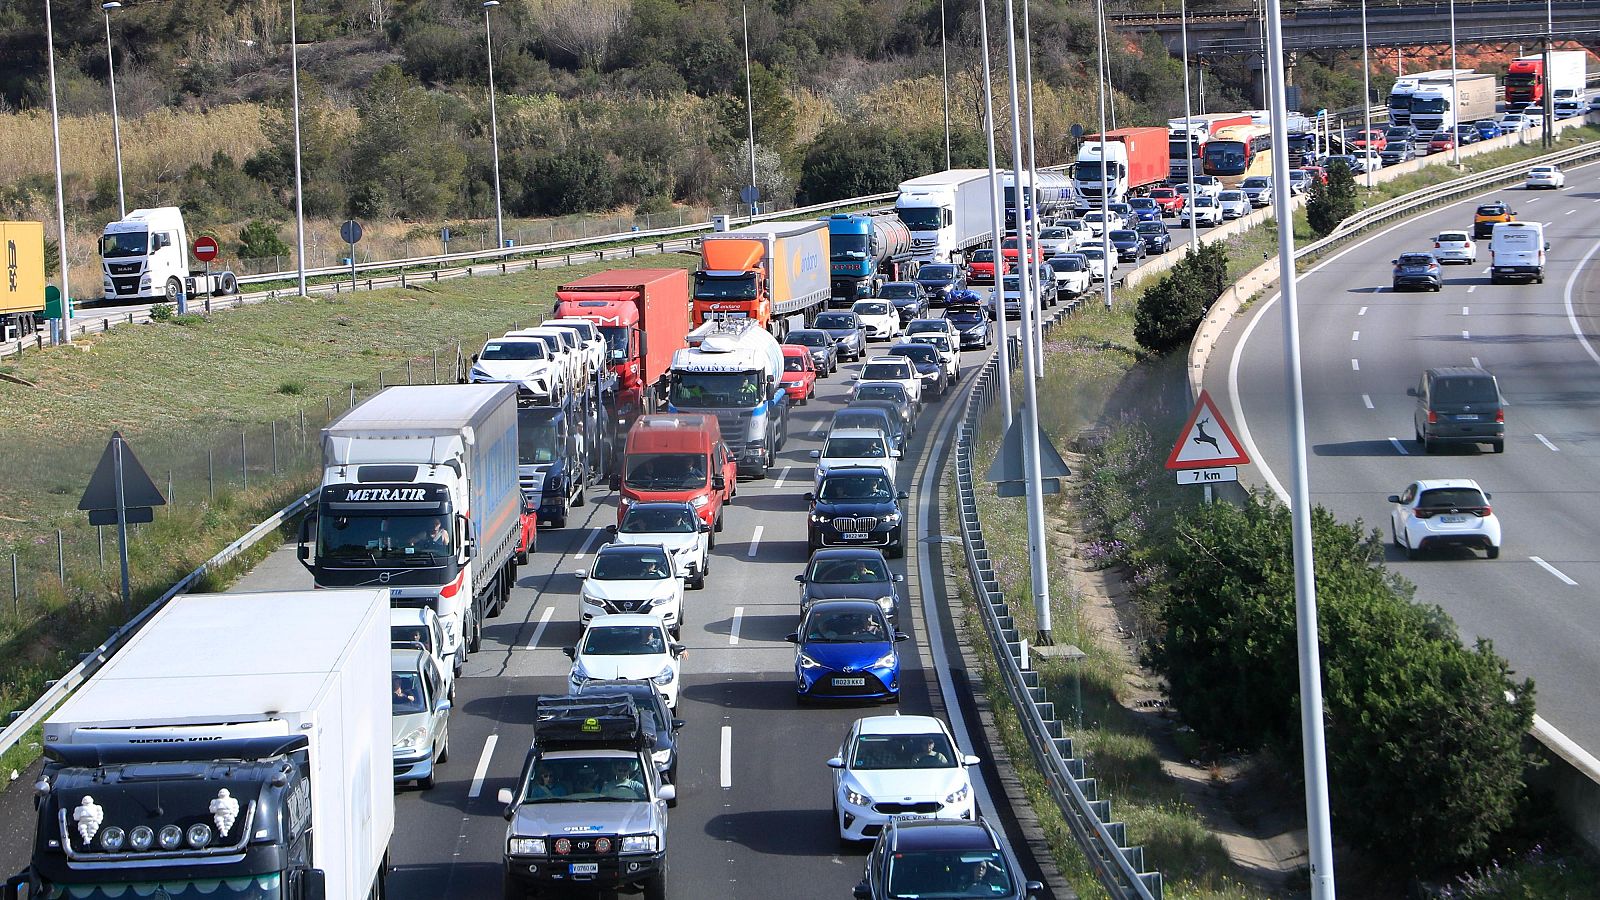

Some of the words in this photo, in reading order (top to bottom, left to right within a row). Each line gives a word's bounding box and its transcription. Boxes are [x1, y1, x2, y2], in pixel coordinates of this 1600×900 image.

[1193, 471, 1200, 481] 7
[1204, 470, 1221, 481] km
[345, 488, 427, 501] METRATIR
